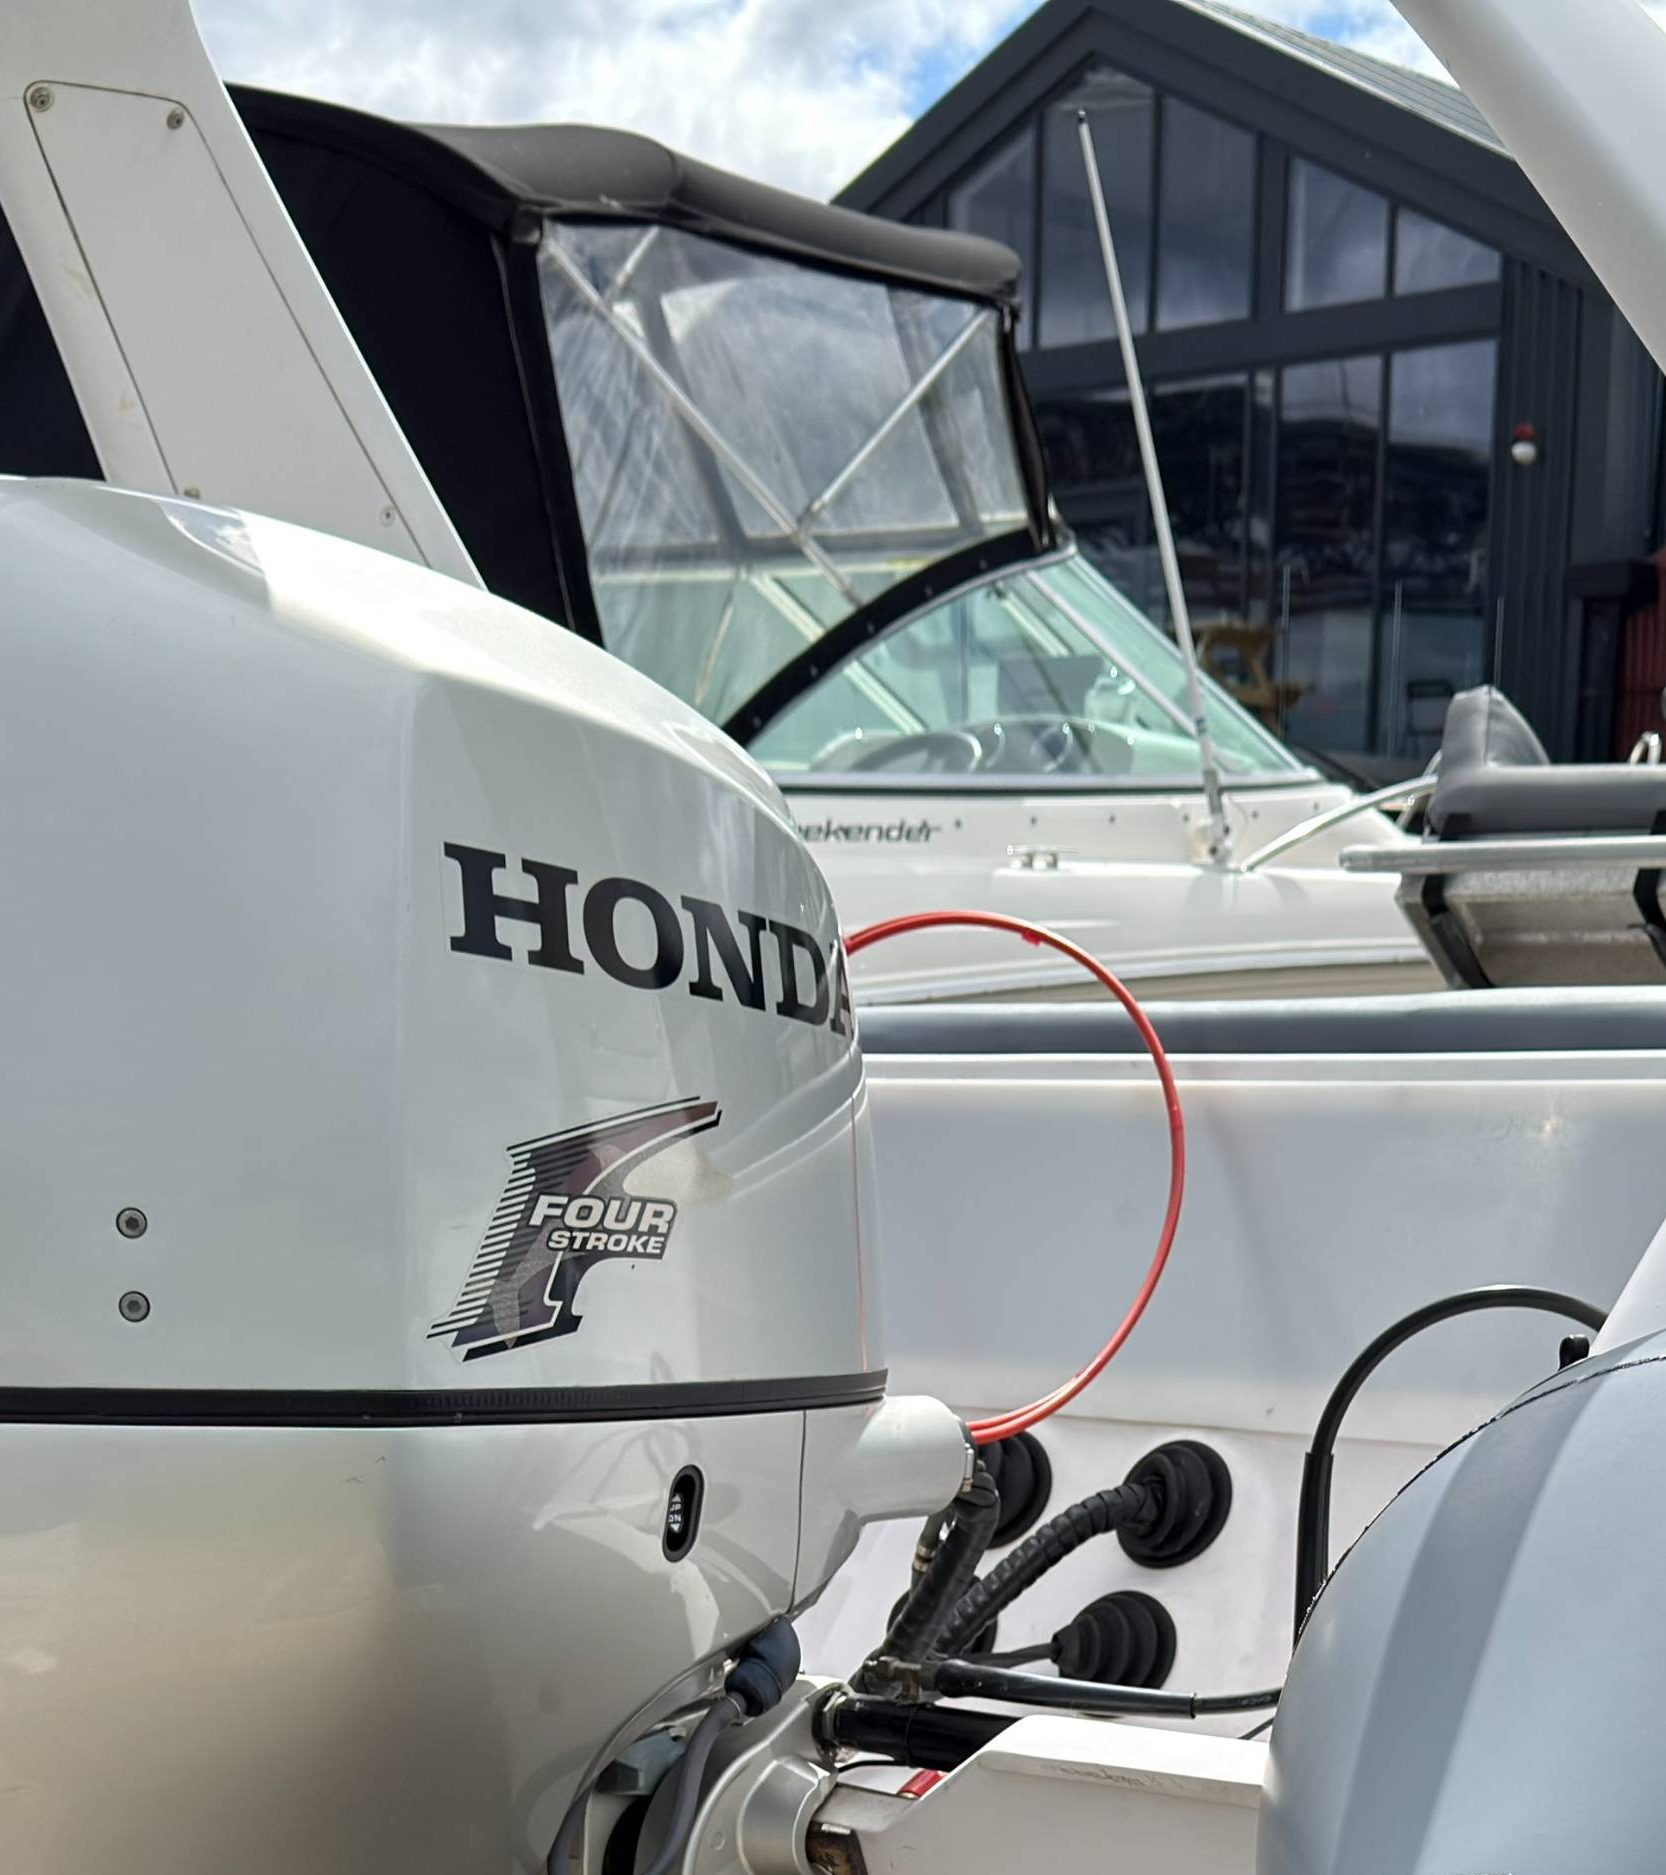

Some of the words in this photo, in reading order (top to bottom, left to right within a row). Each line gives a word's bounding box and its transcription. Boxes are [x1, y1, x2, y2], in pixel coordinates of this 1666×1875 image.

[443, 841, 854, 1037] HONDA
[528, 1194, 676, 1235] FOUR
[548, 1230, 666, 1254] STROKE
